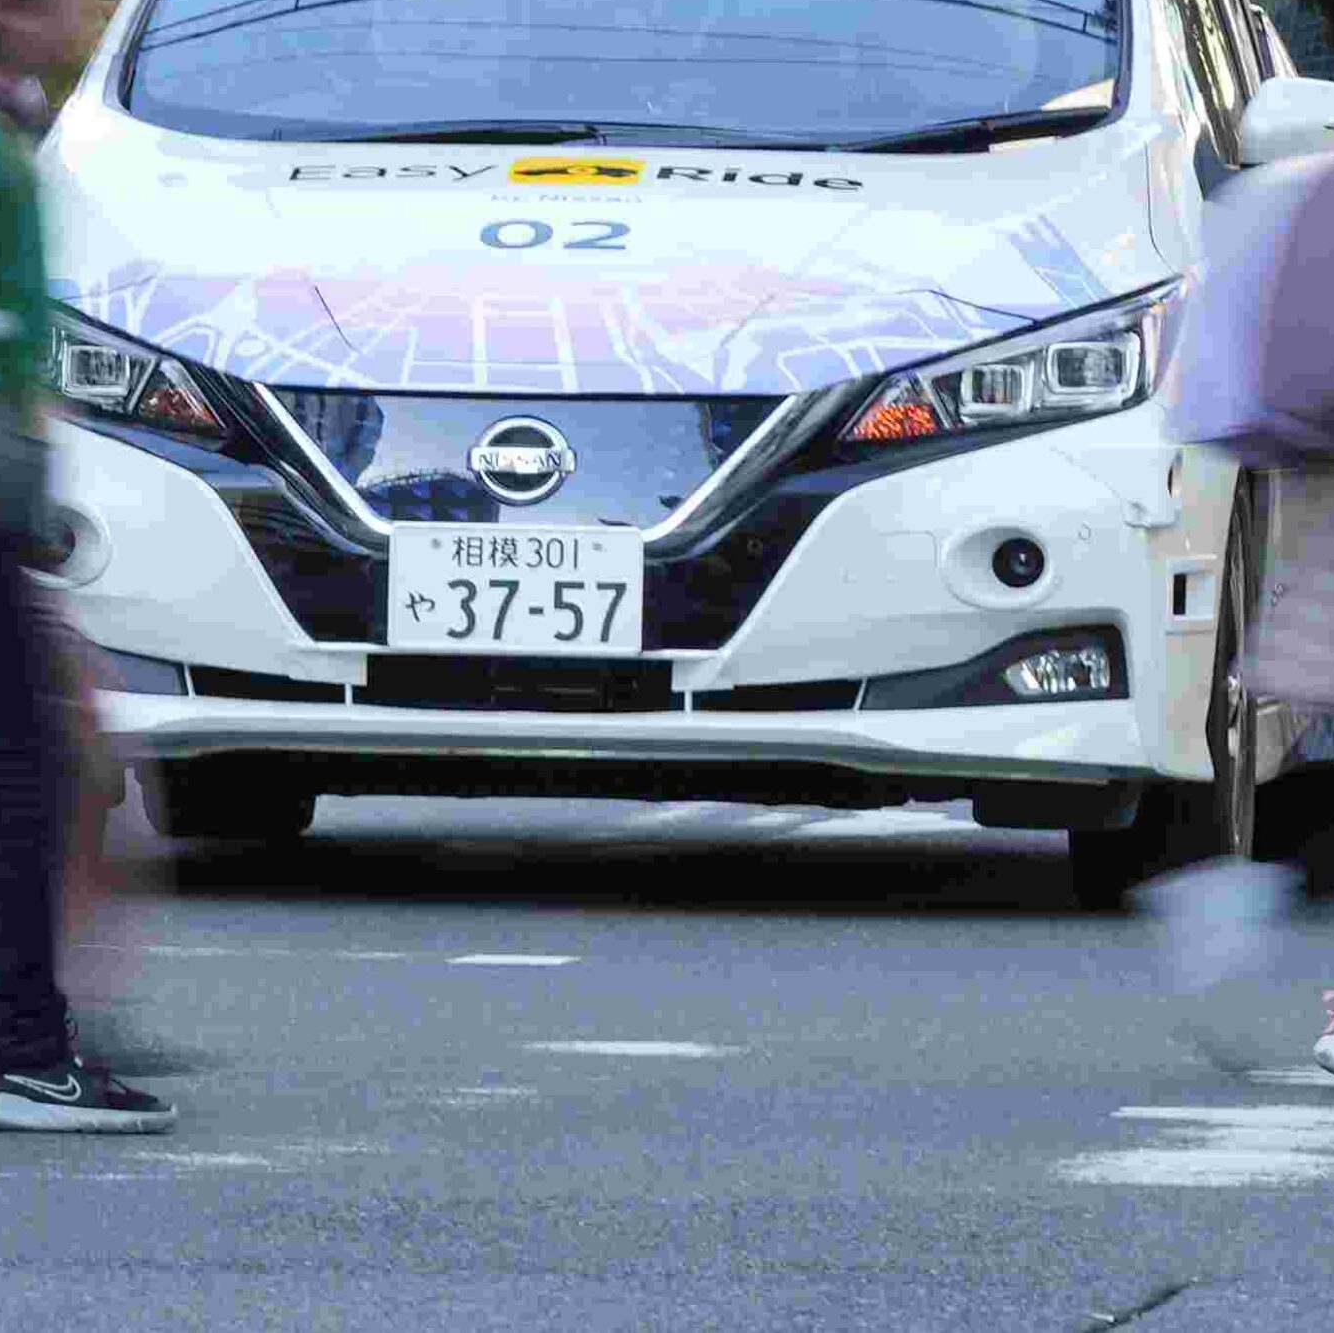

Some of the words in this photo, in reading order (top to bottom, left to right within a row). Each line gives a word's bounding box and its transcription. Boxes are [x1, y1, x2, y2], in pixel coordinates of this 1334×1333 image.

[288, 164, 500, 182] Easy
[656, 166, 864, 191] Ride
[479, 219, 631, 250] 02
[445, 577, 628, 644] 37-57
